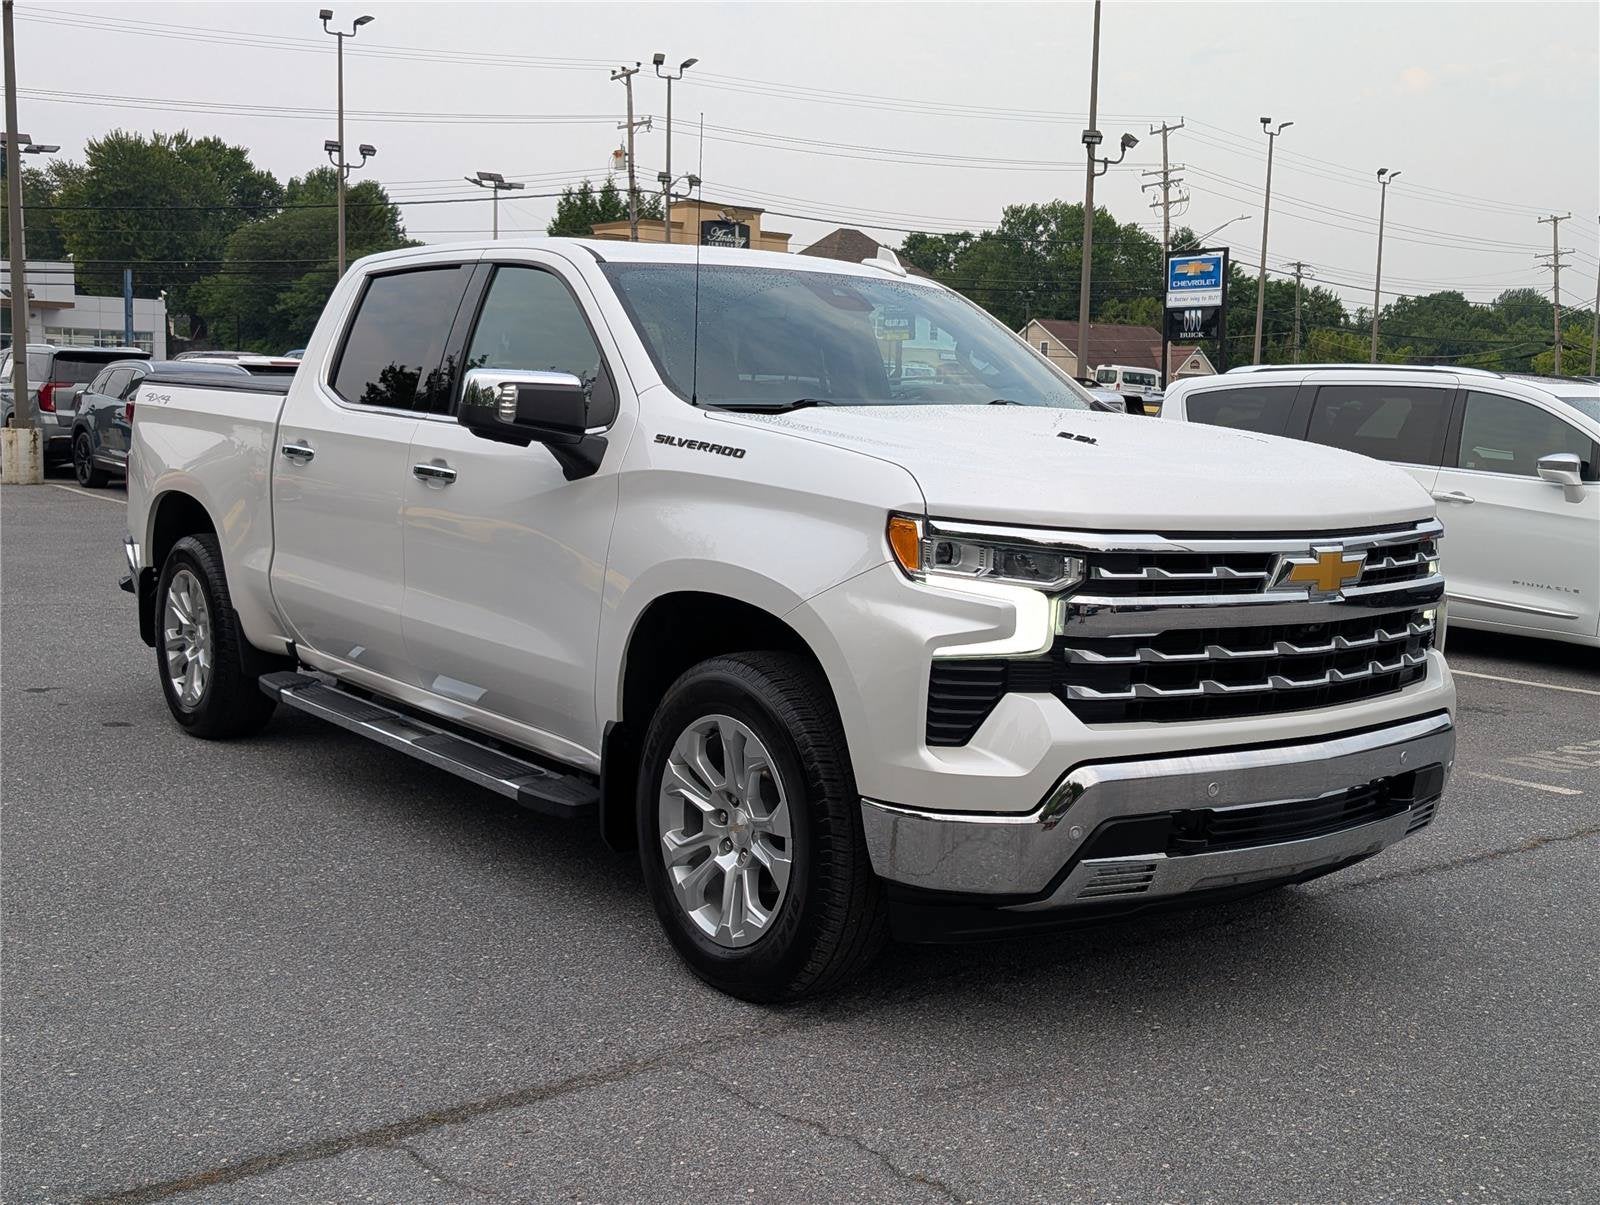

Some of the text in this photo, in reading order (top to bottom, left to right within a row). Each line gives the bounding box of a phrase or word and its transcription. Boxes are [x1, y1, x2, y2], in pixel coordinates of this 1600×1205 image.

[1173, 279, 1216, 288] CHEVROLET
[653, 433, 746, 459] SILVERADO
[1512, 580, 1580, 593] PINNACLE
